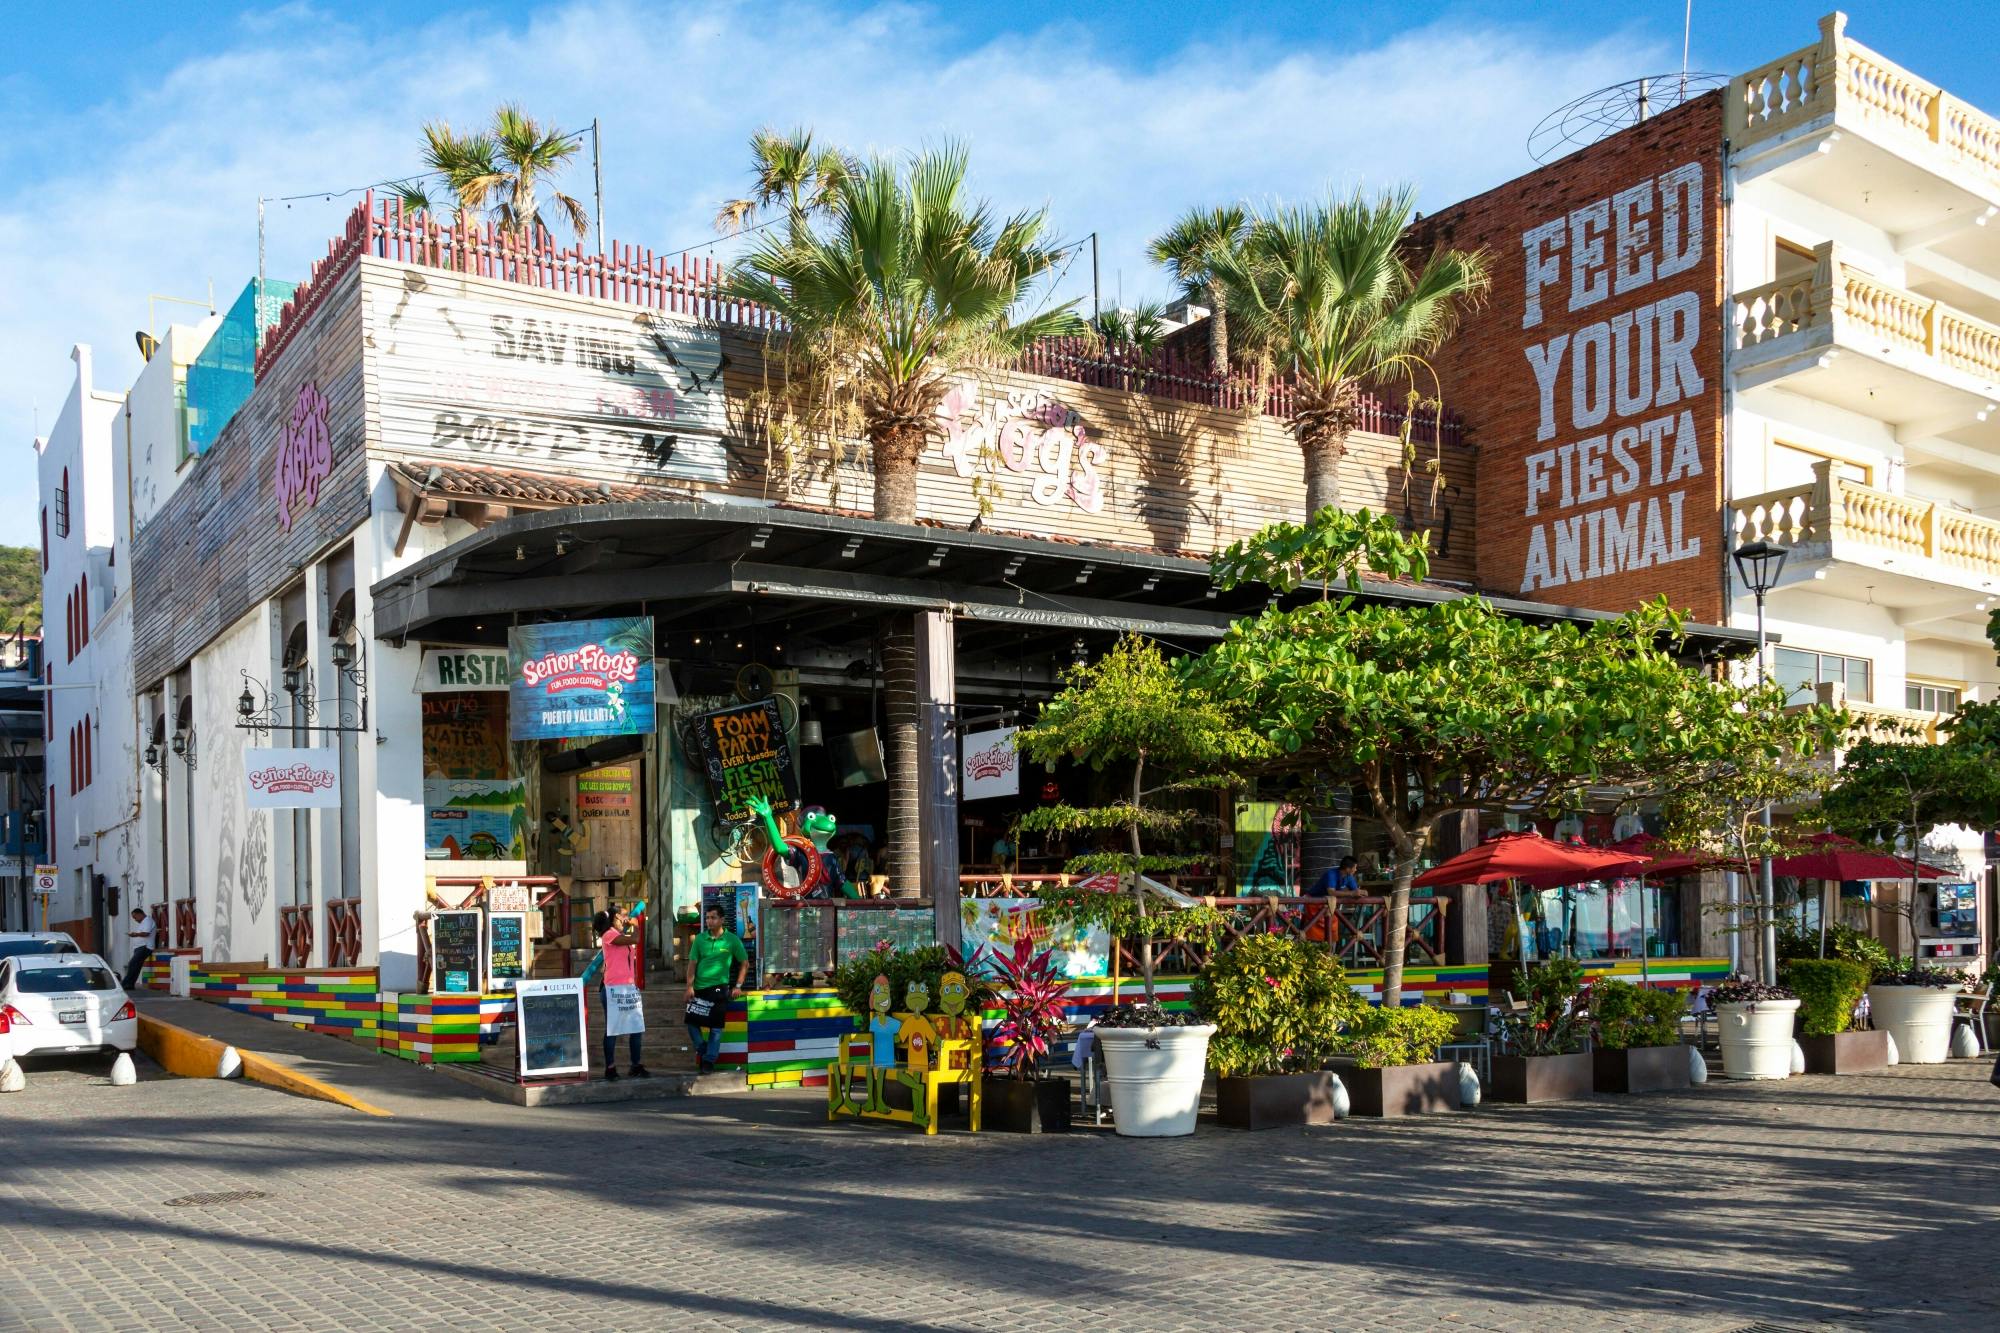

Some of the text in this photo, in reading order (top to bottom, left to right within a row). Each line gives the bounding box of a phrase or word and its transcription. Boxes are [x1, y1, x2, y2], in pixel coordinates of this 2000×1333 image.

[1522, 162, 1703, 330] FEED
[1524, 291, 1704, 442] YOUR
[1525, 410, 1703, 517] FIESTA
[1520, 491, 1701, 594] ANIMAL
[522, 652, 580, 687] Señor
[579, 644, 639, 682] Frog's
[562, 677, 577, 687] FOOD
[580, 677, 603, 687] CLOTHES
[542, 707, 615, 726] PUERTO VALLARTA
[713, 709, 771, 738] FOAM
[717, 733, 769, 760] PARTY
[721, 748, 779, 769] EVERY tuesday
[249, 762, 335, 790] Señor Frog's
[723, 760, 780, 791] FIESTA
[725, 810, 748, 821] Todos
[549, 983, 578, 992] ULTRA
